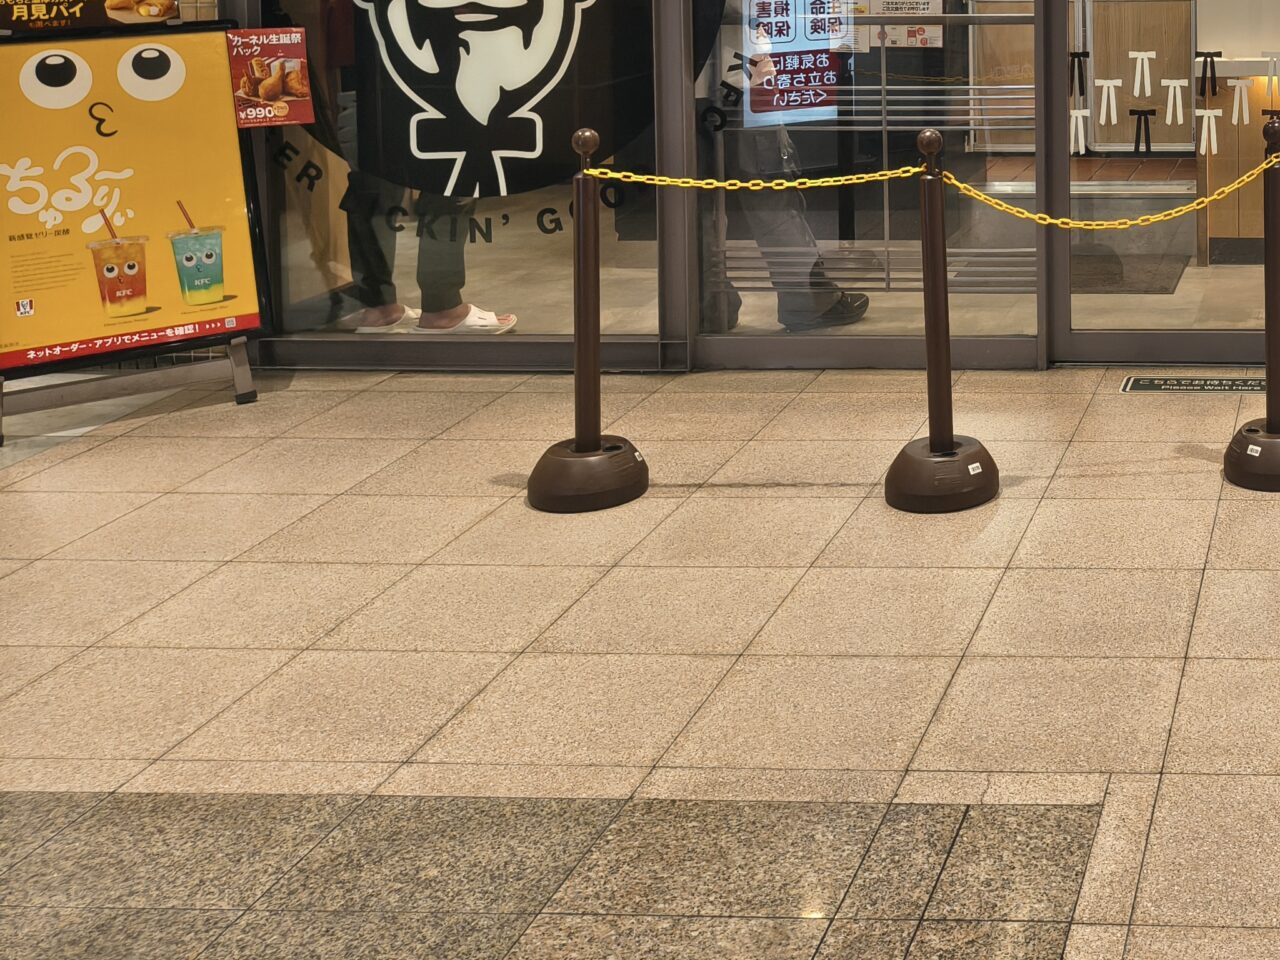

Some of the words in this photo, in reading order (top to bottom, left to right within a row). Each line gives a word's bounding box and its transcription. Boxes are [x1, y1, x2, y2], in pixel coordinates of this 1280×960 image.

[11, 2, 84, 21] 月見パイ
[231, 33, 302, 46] カーネル生誕祭
[240, 106, 275, 120] ¥990
[1139, 378, 1266, 386] こちらでお待ちくだ
